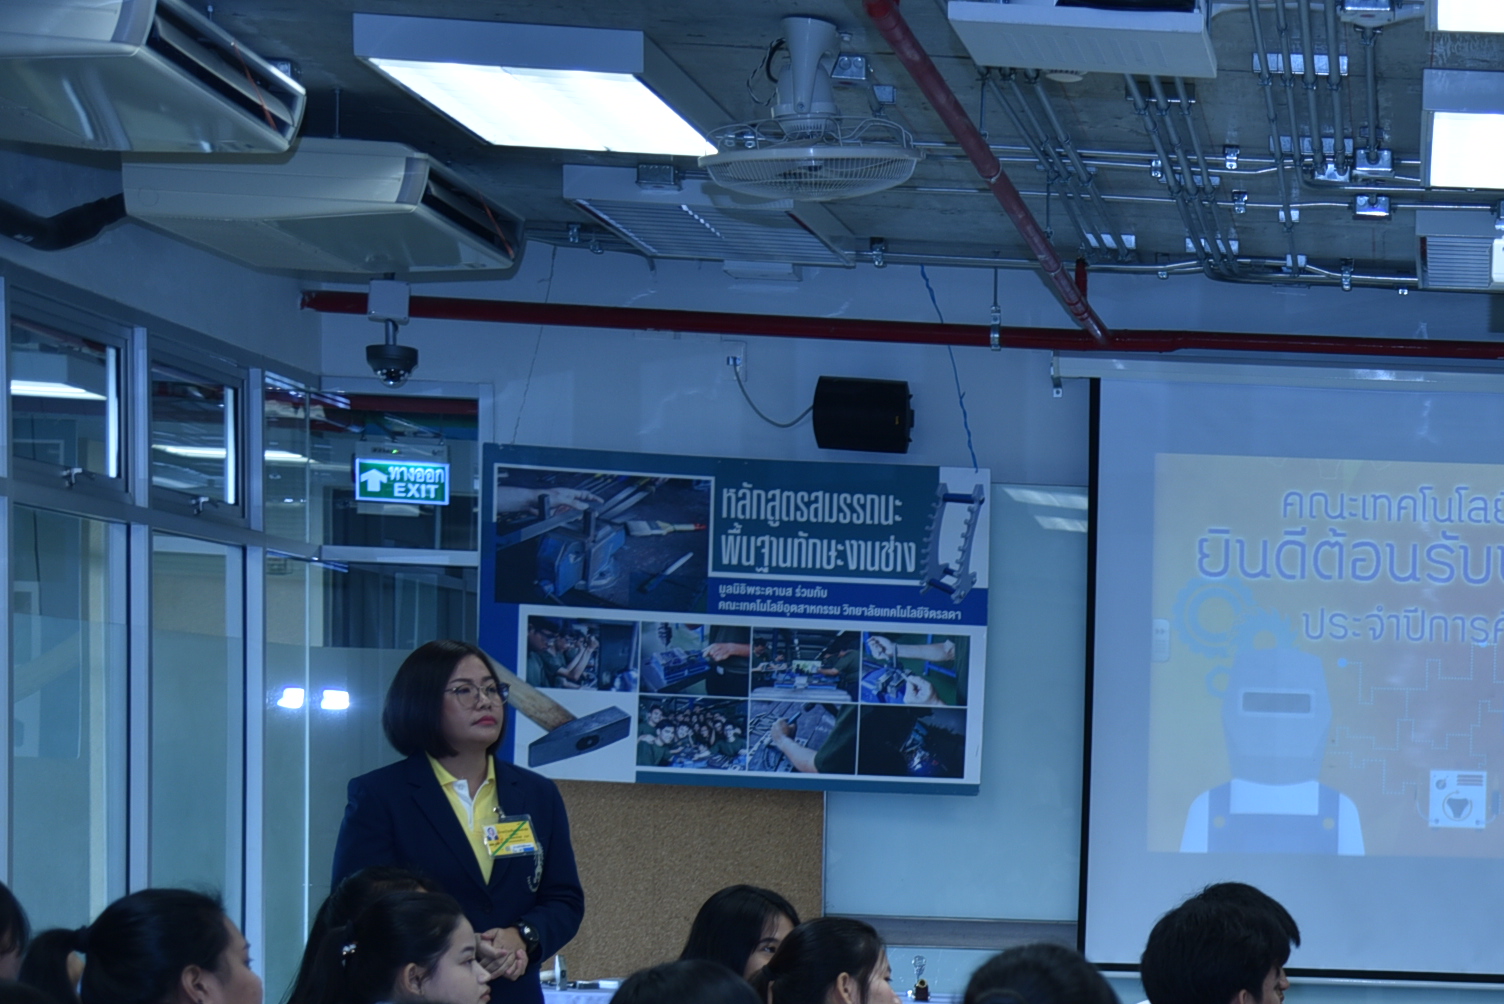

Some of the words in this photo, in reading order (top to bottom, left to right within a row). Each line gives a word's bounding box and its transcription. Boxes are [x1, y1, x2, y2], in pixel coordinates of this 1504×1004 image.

[388, 465, 445, 483] ทางออก
[393, 482, 439, 499] EXIT
[721, 482, 903, 527] หลักสูตรสมรรถนะ
[721, 522, 917, 574] พื้นฐานทักษะงานช่าง
[718, 582, 793, 598] มูลนิธิพระดาบส
[795, 584, 828, 599] ร่วมกับ
[718, 599, 841, 617] คณะเทคโนโลยีอุตสาหกรรม
[842, 603, 962, 621] วิทยาลัยเทคโนโลยีจิตรลดา
